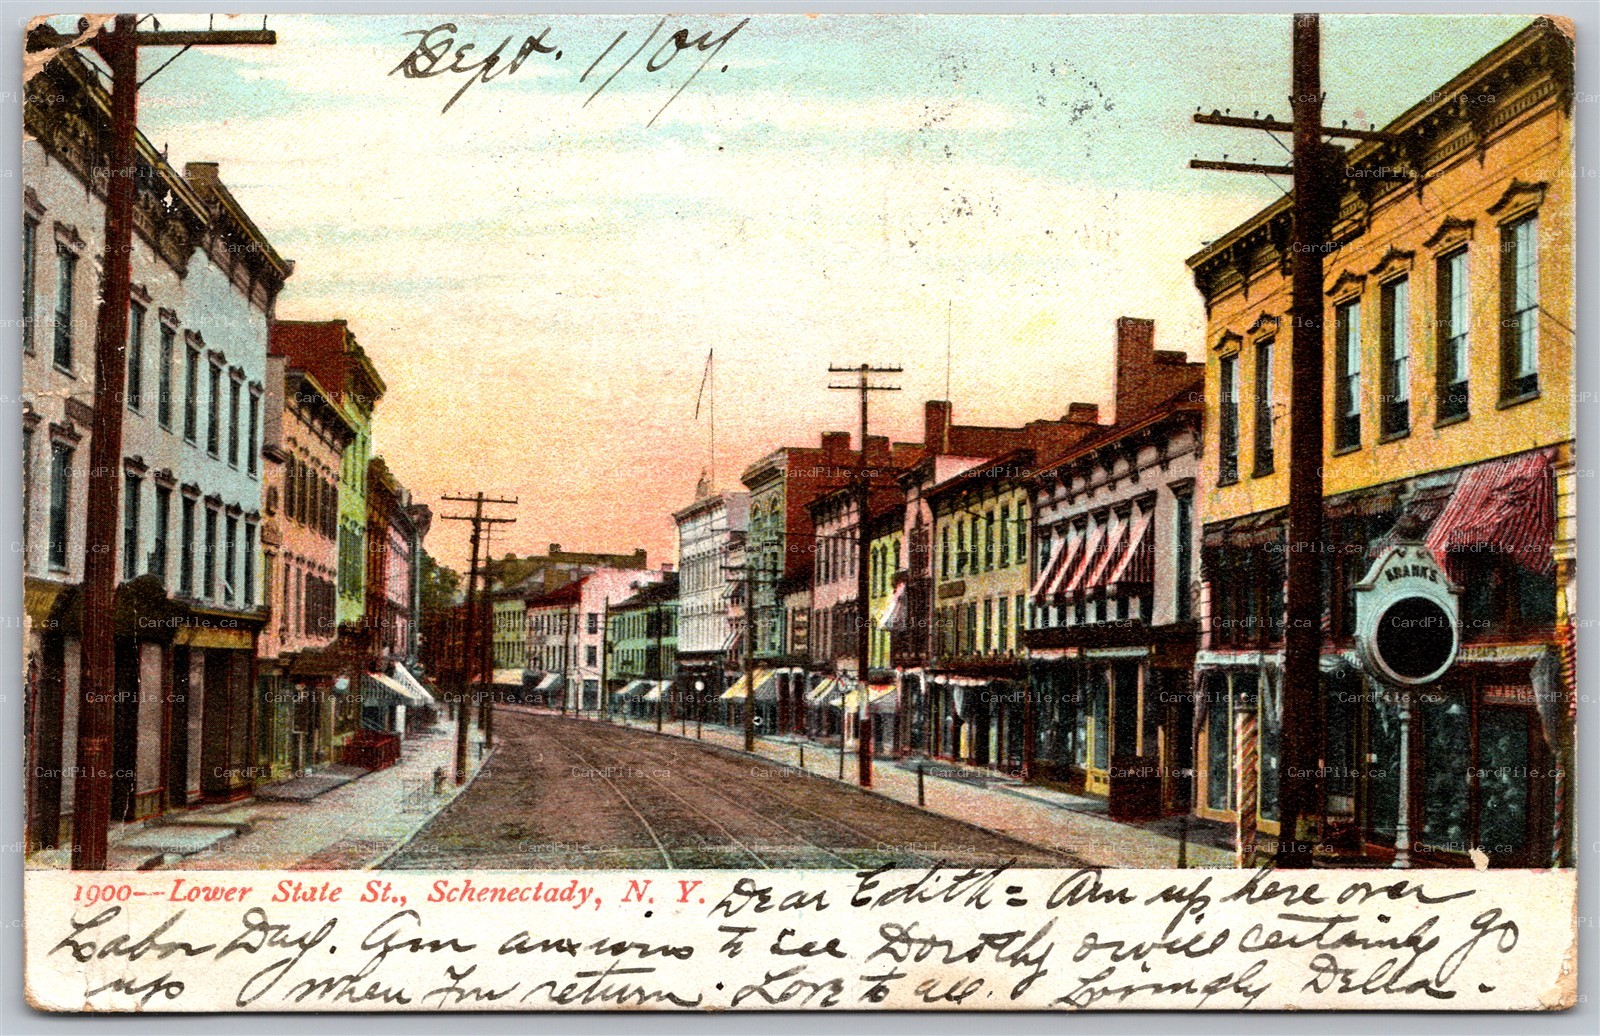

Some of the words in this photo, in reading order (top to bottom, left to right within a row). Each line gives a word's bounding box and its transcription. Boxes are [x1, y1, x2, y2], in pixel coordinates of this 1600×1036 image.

[387, 22, 563, 115] Sept.
[271, 879, 343, 903] State
[359, 879, 407, 907] St.,
[426, 879, 602, 910] Schenectady,
[621, 879, 655, 904] N.
[677, 879, 705, 904] Y.
[707, 877, 830, 919] Dear
[1046, 866, 1138, 910] Am
[1144, 876, 1214, 938] up
[1221, 858, 1332, 906] here
[1336, 880, 1477, 905] over
[48, 906, 216, 962] Labor
[215, 907, 338, 985] Day.
[717, 925, 758, 960] to
[865, 917, 1058, 988] Dorothy
[1238, 914, 1440, 970] certainly
[1436, 907, 1520, 988] go
[85, 970, 185, 1005] up
[282, 952, 412, 1005] when
[857, 966, 907, 1003] to
[1048, 960, 1273, 1009] Lovingly
